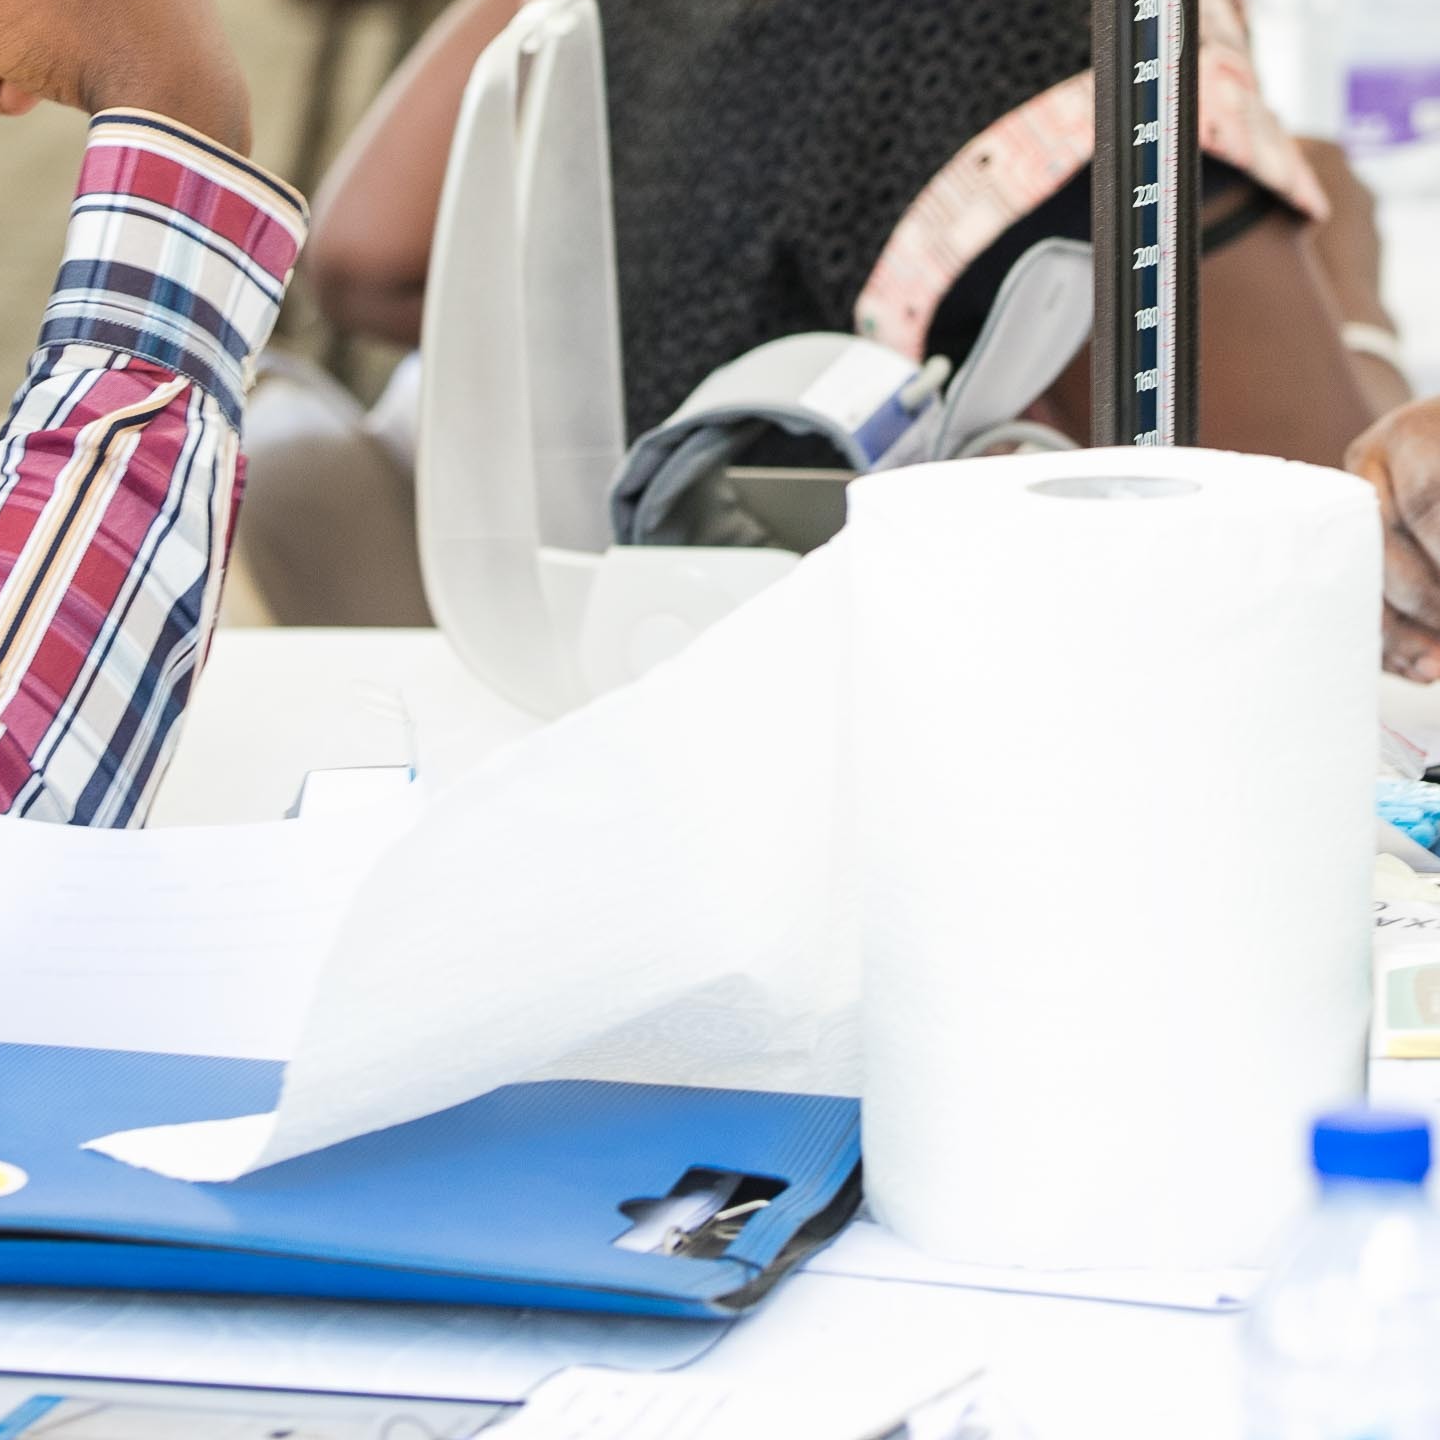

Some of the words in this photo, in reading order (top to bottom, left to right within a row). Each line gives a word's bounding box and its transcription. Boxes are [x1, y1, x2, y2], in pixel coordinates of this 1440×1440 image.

[1133, 58, 1160, 84] 260
[1133, 120, 1160, 146] 240
[1132, 182, 1160, 208] 220
[1133, 244, 1160, 270] 200
[1134, 306, 1160, 332] 180
[1134, 368, 1160, 393] 160
